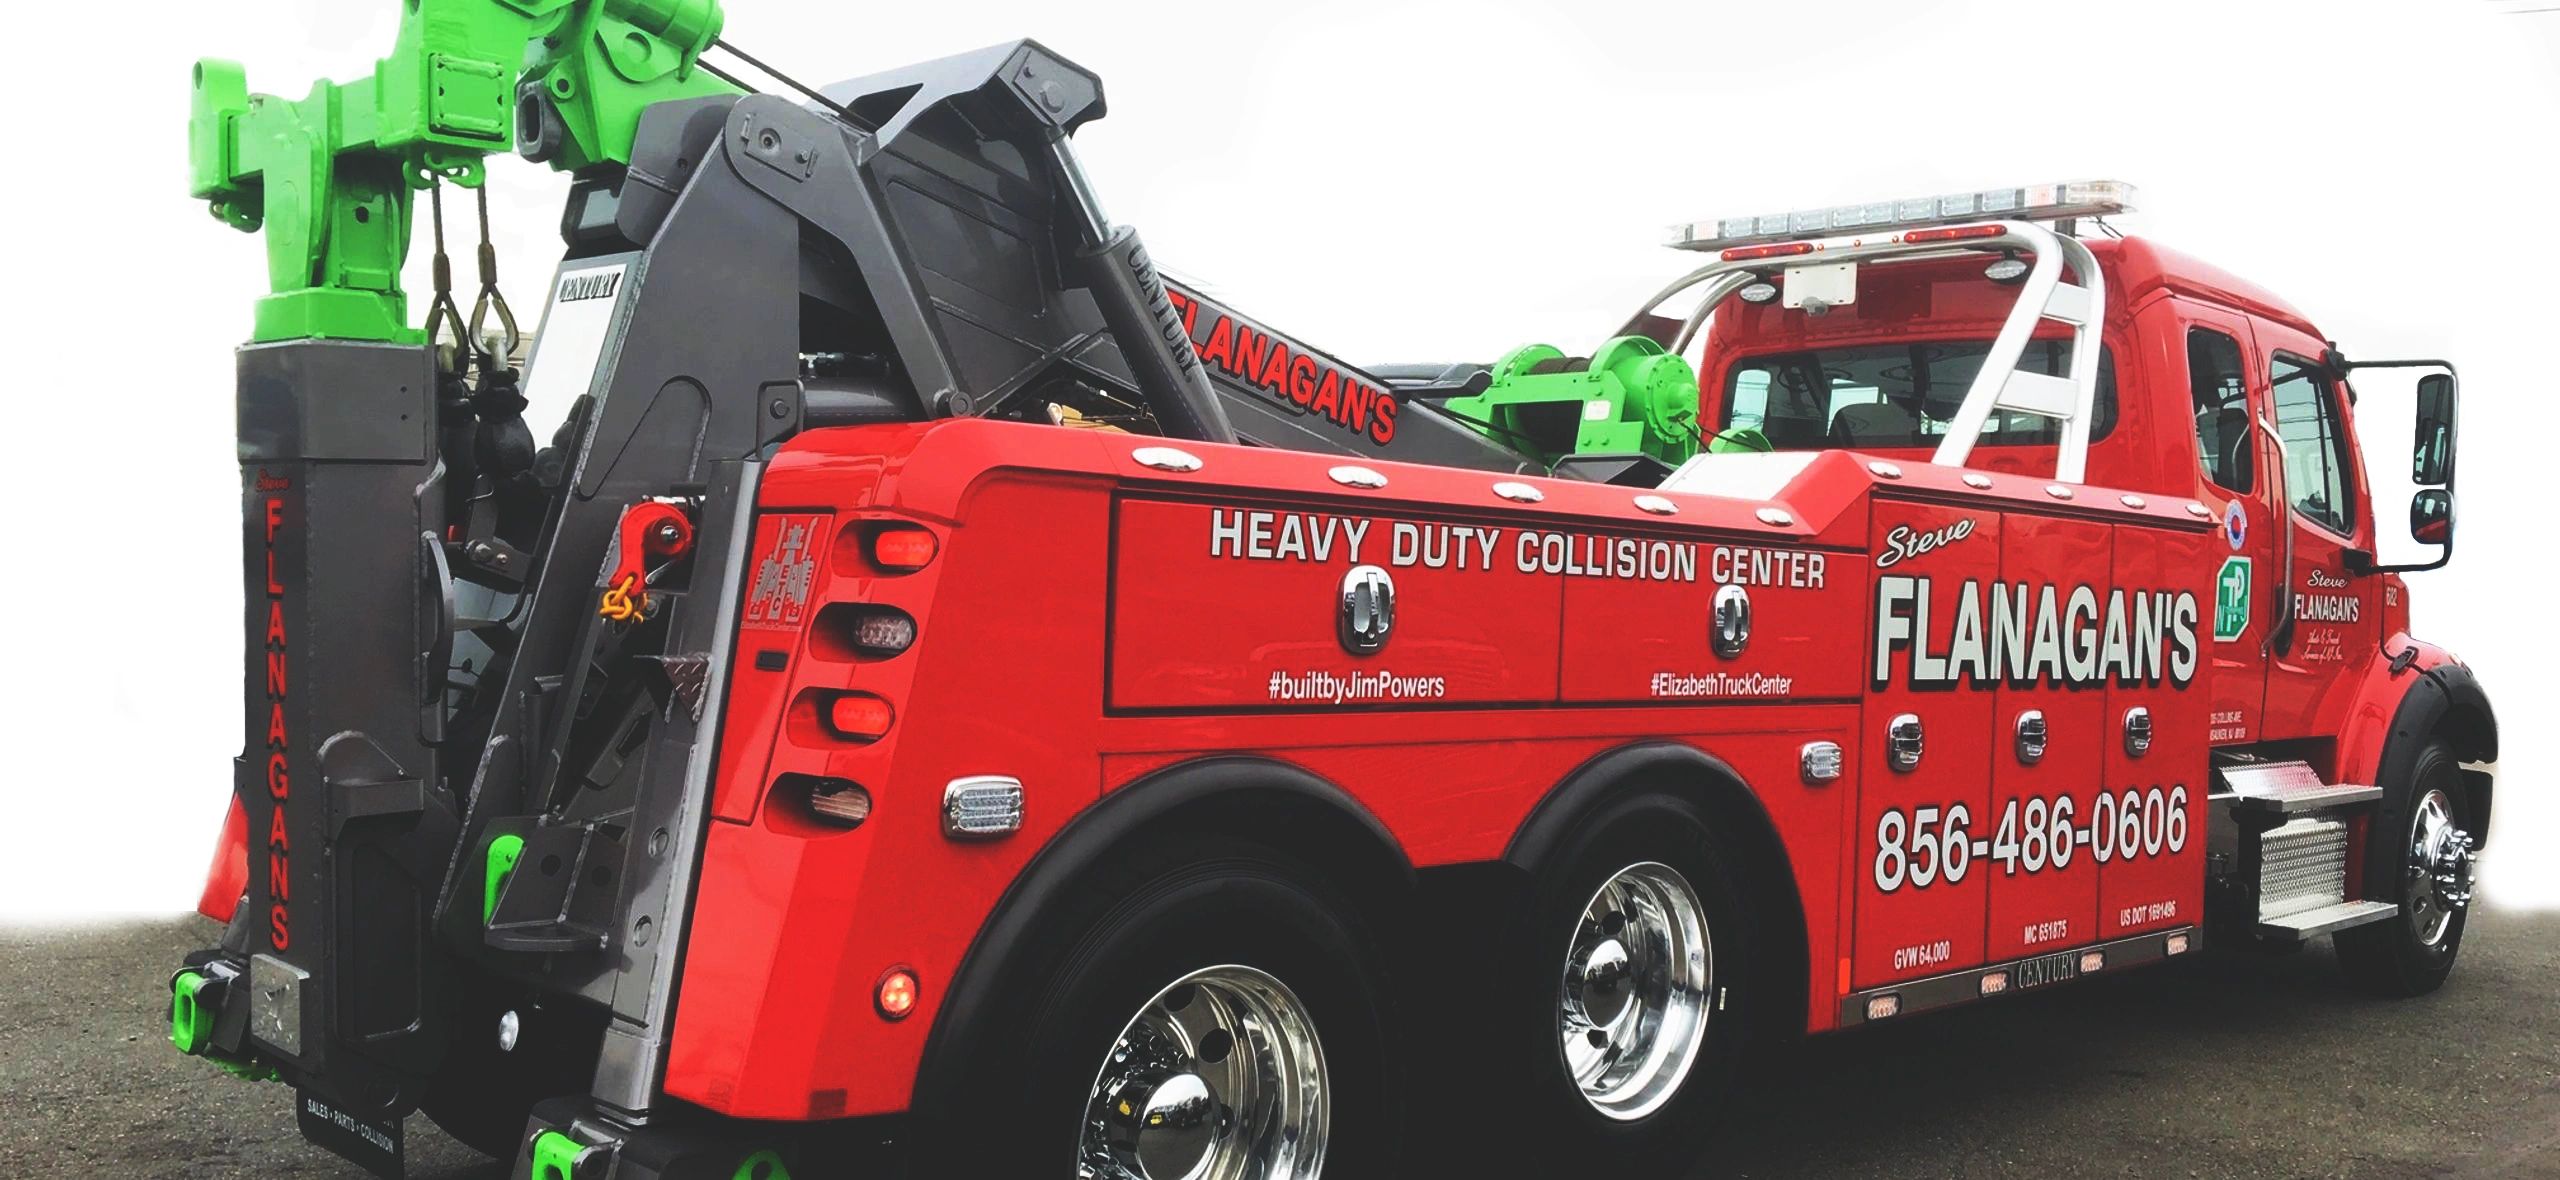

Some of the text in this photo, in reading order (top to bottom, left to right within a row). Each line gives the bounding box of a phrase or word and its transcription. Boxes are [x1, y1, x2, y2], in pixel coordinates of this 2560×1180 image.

[560, 272, 621, 302] CENTURY
[1128, 244, 1198, 377] CENTURY
[1166, 287, 1397, 445] LANAGAN'S
[1210, 509, 1826, 589] HEAVY DUTY COLLISION CENTER
[1876, 518, 1976, 568] Steve
[2307, 570, 2347, 588] Steve
[2294, 594, 2359, 623] FLANAGAN'S
[1874, 576, 2198, 686] FLANAGAN'S
[1268, 671, 1445, 704] #builtbyJimPowers
[1651, 673, 1793, 697] #ElizabethTruckCenter
[265, 498, 289, 953] FLANAGANS
[1874, 786, 2188, 892] 856-486-0606
[2024, 919, 2067, 945] MC 651875
[2120, 908, 2131, 927] US
[2132, 905, 2147, 925] DOT
[1894, 940, 1950, 970] GVW 64,000
[2018, 953, 2077, 989] CENTURY
[307, 1099, 328, 1119] SALES
[334, 1110, 355, 1132] PARTS
[361, 1124, 394, 1155] COLLISION
